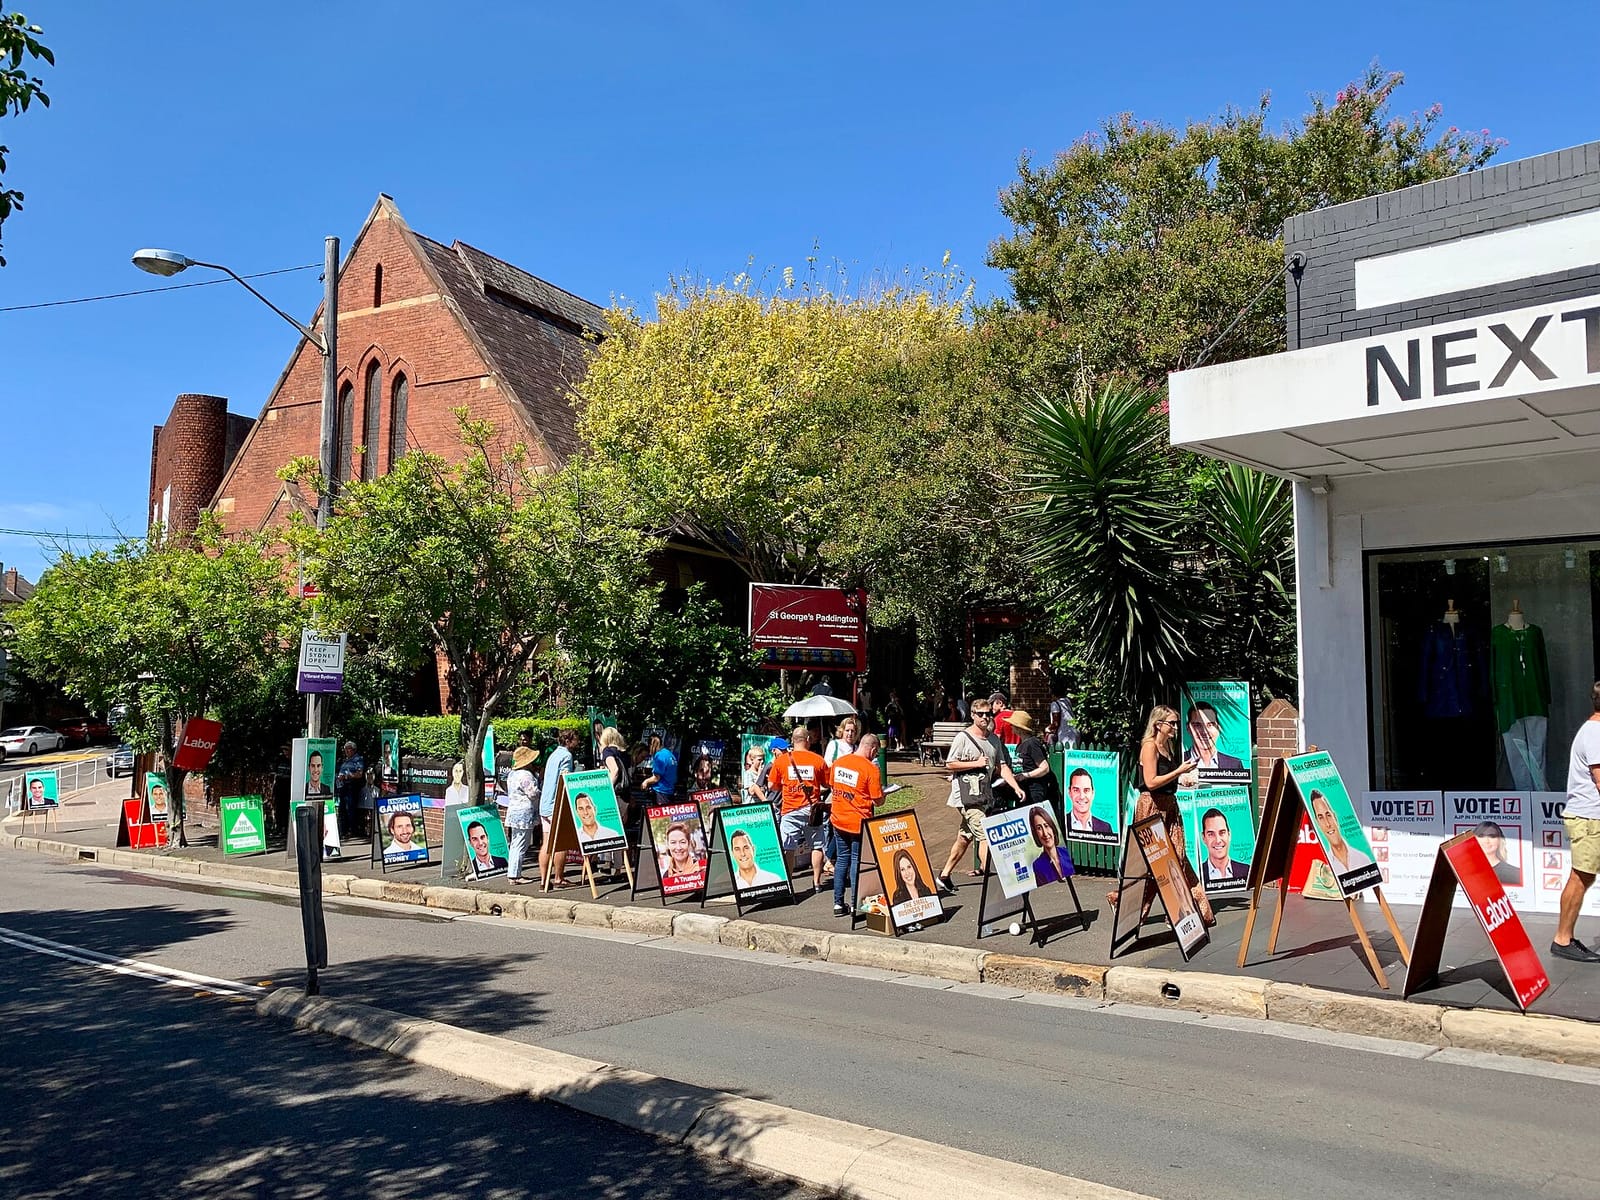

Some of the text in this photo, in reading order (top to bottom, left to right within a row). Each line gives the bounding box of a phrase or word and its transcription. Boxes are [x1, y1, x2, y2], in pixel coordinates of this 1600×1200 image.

[1366, 306, 1600, 406] NEXT
[780, 612, 814, 622] George's
[816, 613, 858, 624] Paddington
[183, 736, 216, 750] Labor
[1200, 770, 1249, 778] greenwich.com
[1210, 789, 1245, 797] GREENWICH
[226, 801, 246, 810] VOTE
[380, 802, 419, 813] GANNON
[648, 804, 695, 818] Jo Holder
[736, 806, 769, 816] GREENWICH
[1370, 800, 1414, 816] VOTE
[1454, 798, 1500, 814] VOTE
[1541, 802, 1566, 819] VO
[883, 832, 910, 844] VOTE 1
[989, 821, 1026, 843] GLADYS
[1137, 827, 1153, 847] SBP
[384, 855, 409, 863] SYDNEY
[1206, 879, 1246, 888] alexgreenwich.
[1475, 895, 1513, 933] Labor
